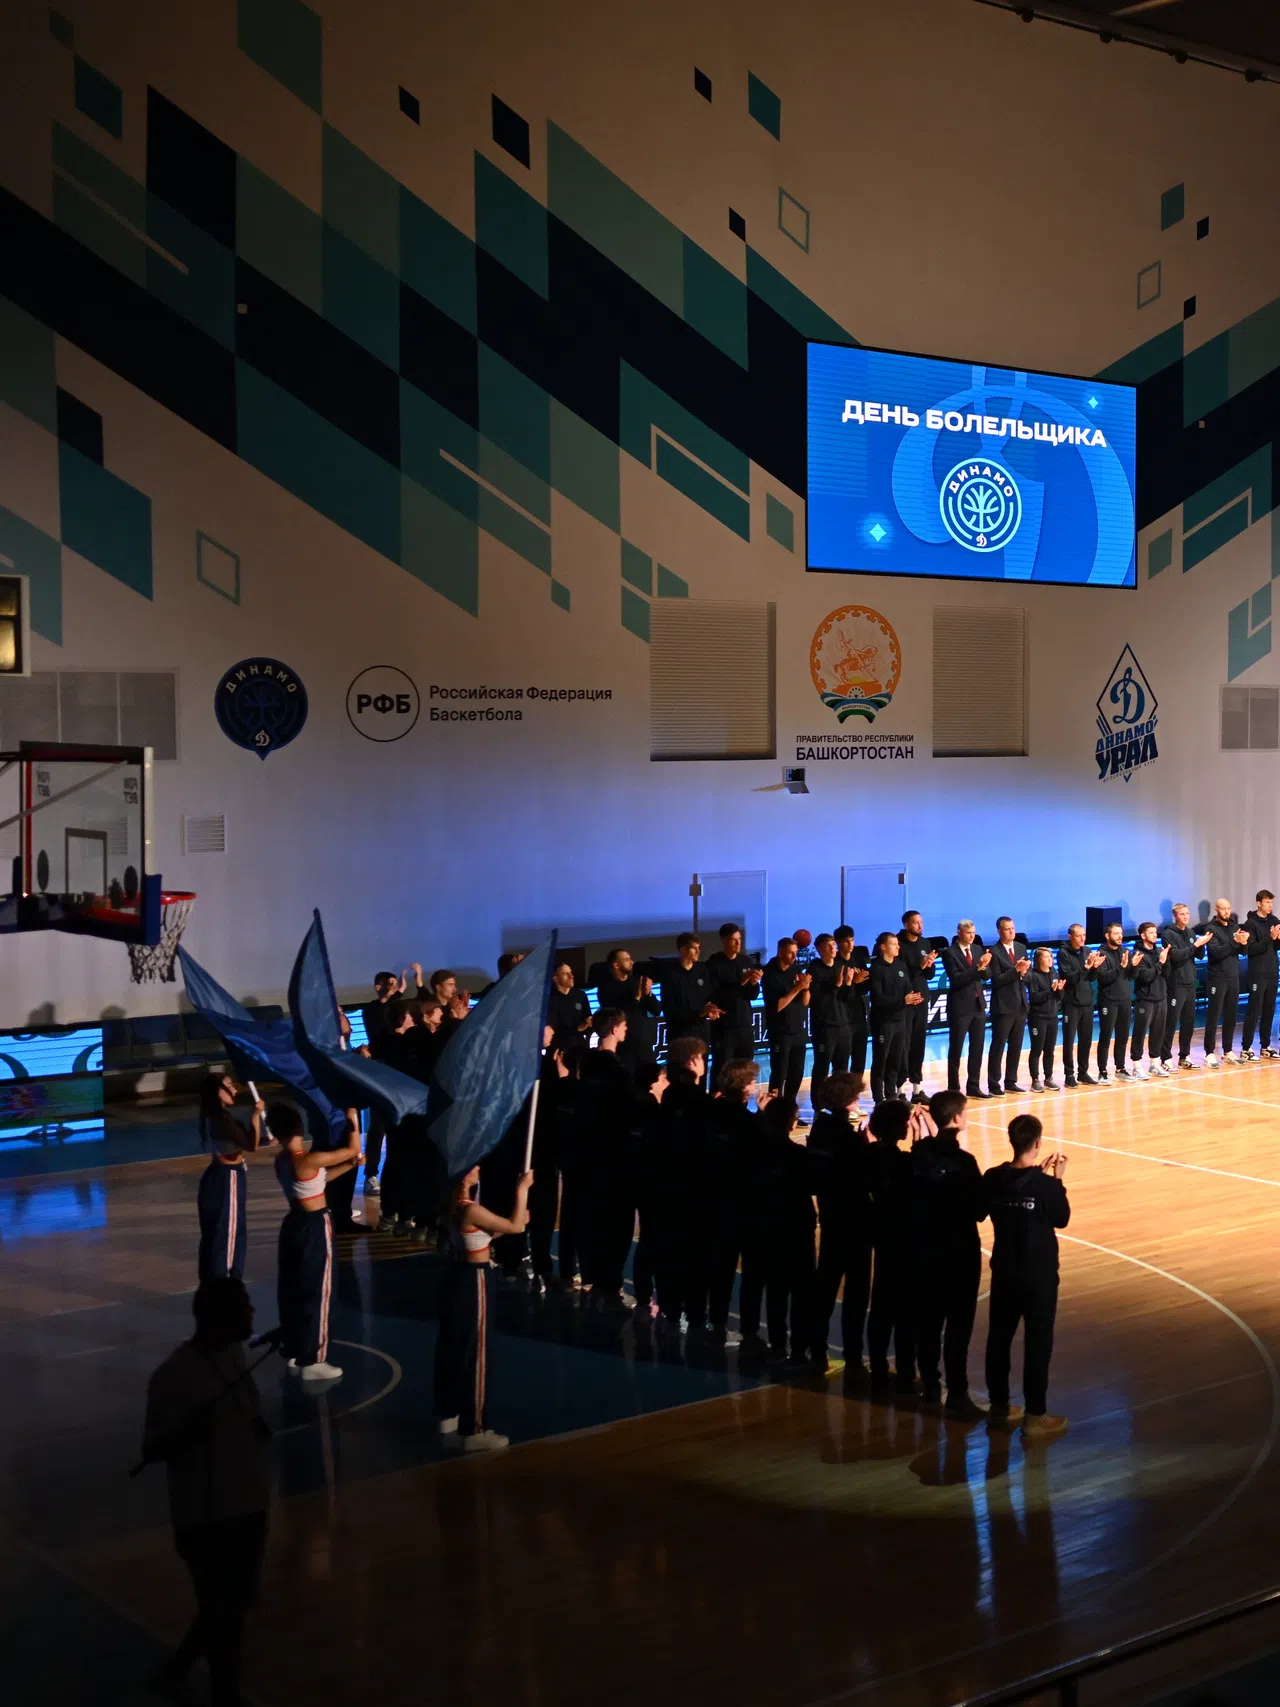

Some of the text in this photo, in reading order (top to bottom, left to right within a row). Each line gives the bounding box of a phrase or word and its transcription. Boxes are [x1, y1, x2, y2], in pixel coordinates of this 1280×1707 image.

[842, 399, 1107, 447] ДЕНЬ БОЛЕЛЬЩИКА
[948, 464, 1014, 497] ДИНАМО
[224, 664, 298, 694] ДИНАМО
[356, 694, 411, 714] РФБ
[429, 685, 613, 704] Российская Федерация
[429, 707, 523, 722] Баскетбола
[796, 734, 914, 743] ПРАВИТЕЛЬСТВО РЕСПУБЛИКИ
[796, 745, 914, 761] БАШКОРТОСТАН
[1095, 732, 1159, 780] УРАЛ
